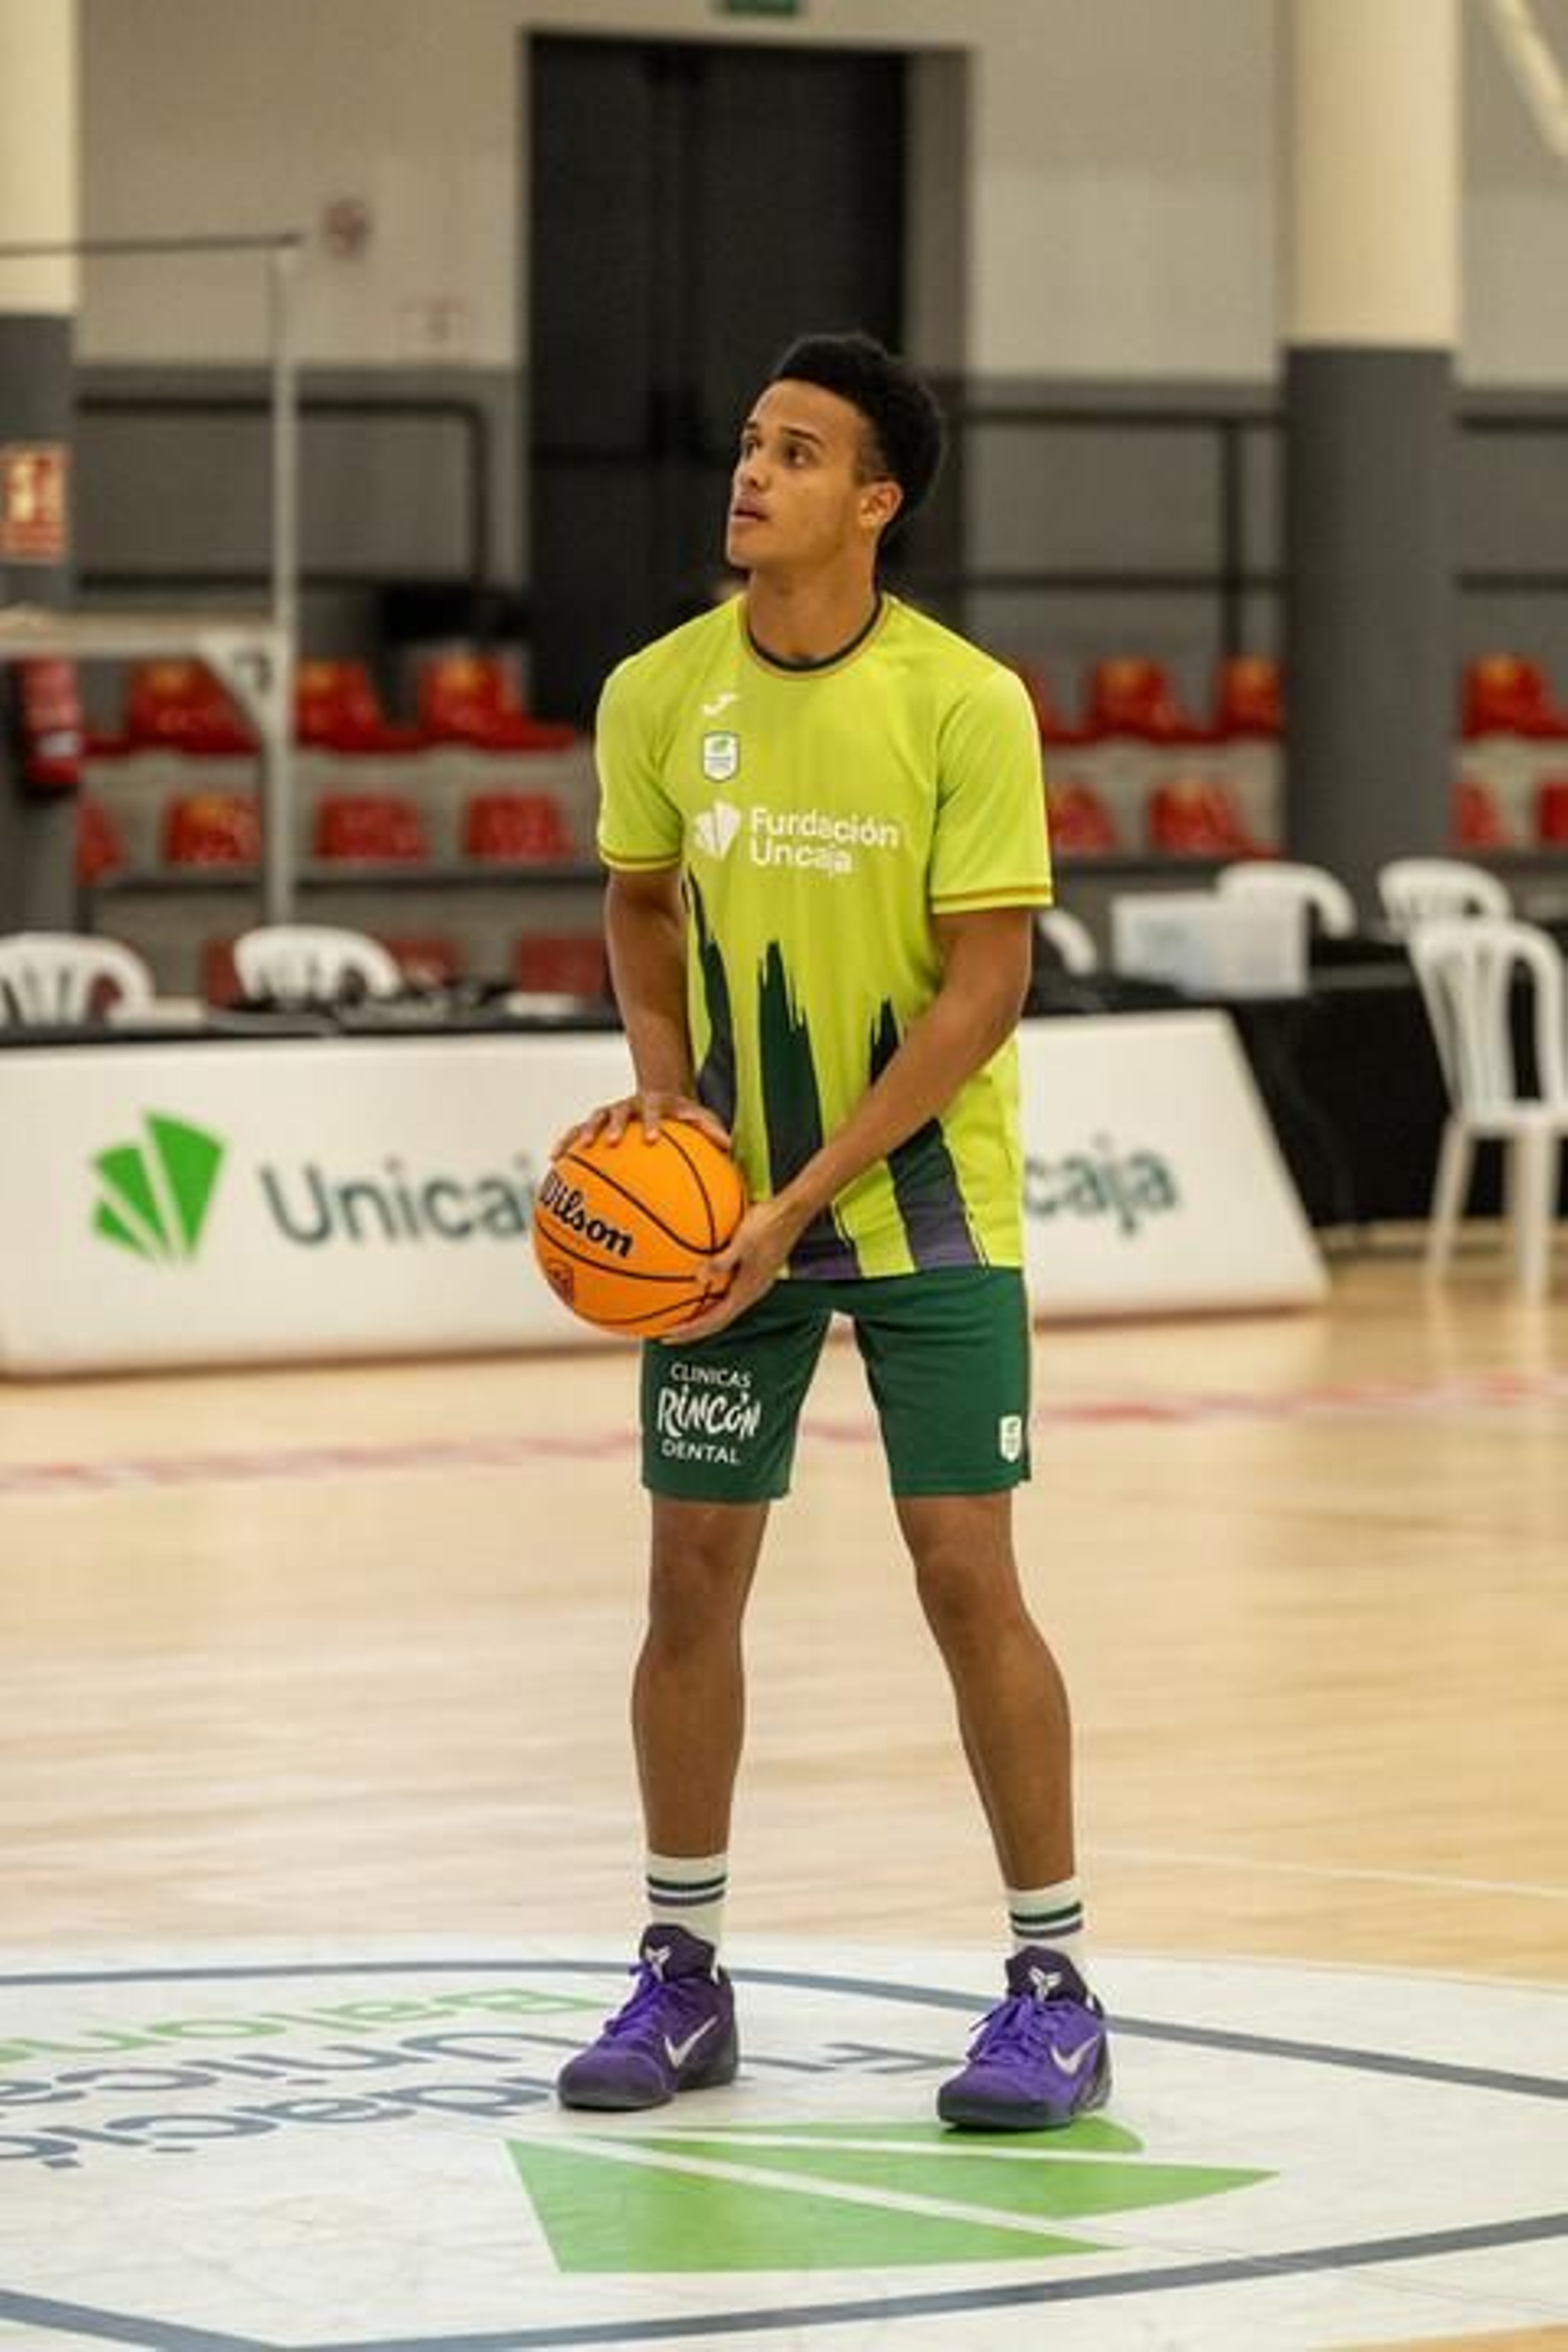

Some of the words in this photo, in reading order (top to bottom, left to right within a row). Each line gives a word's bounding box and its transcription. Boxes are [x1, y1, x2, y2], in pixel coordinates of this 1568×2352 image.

[751, 808, 901, 850] Fundación
[257, 1150, 535, 1248] Unica
[1022, 1131, 1183, 1239] caja
[661, 1438, 742, 1466] DENTAL
[0, 1987, 611, 2064] Balon
[0, 2032, 594, 2118] Unica
